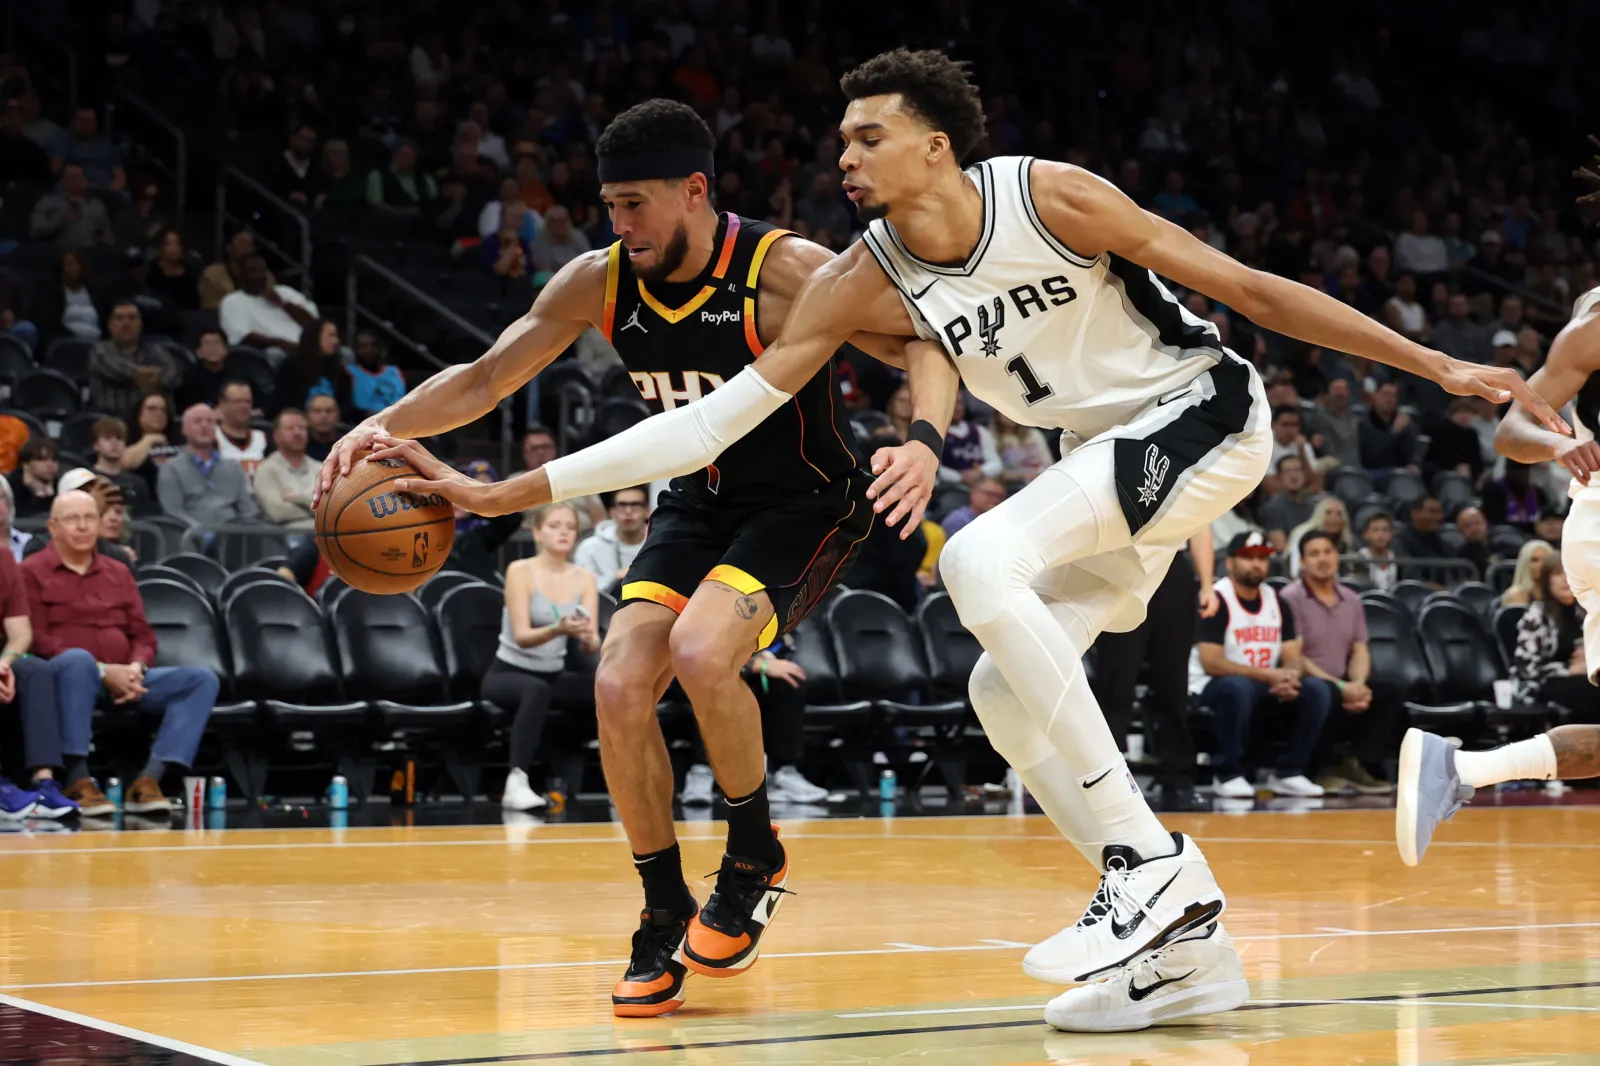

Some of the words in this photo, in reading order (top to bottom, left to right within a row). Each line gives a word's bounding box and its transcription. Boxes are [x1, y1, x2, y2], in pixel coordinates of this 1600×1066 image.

[701, 310, 740, 326] PayPal
[627, 370, 727, 412] PH
[1004, 352, 1056, 407] 1
[1243, 648, 1272, 669] 32
